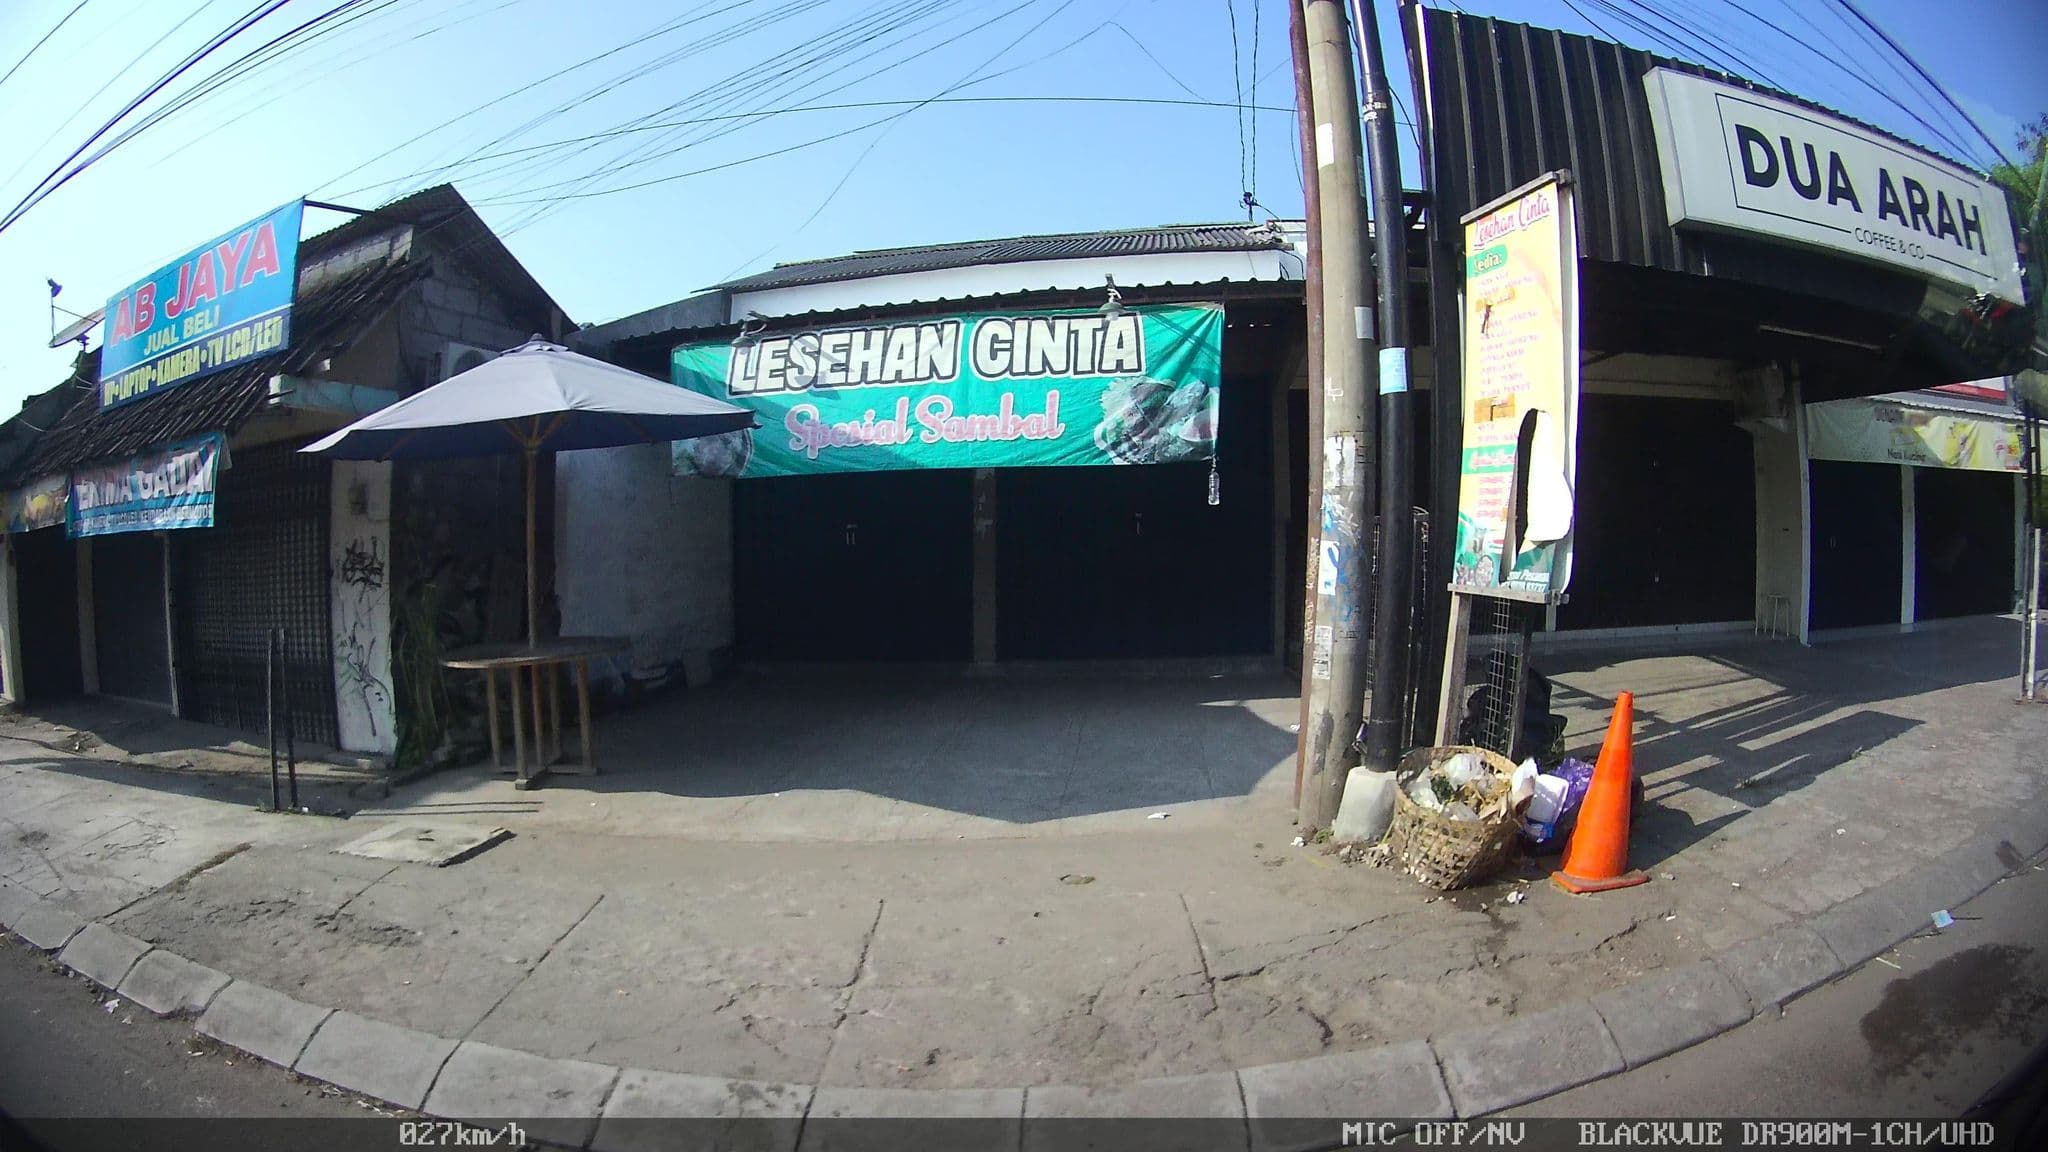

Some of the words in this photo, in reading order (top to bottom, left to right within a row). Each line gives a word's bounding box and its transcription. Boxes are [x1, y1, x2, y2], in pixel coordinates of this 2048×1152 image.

[1518, 192, 1550, 228] Cinta
[1735, 123, 1863, 213] DUA
[1878, 167, 1987, 256] ARAH
[1854, 227, 1897, 252] COFFEE
[1898, 239, 1906, 254] &
[1908, 243, 1925, 260] CO
[111, 281, 156, 347] AB
[165, 220, 280, 318] JAYA
[144, 326, 179, 356] JUAL
[183, 304, 220, 339] BELI
[728, 318, 961, 396] LESEHAN
[971, 312, 1146, 377] CINTA
[785, 396, 913, 460] Spesial
[912, 390, 1065, 445] Sambal
